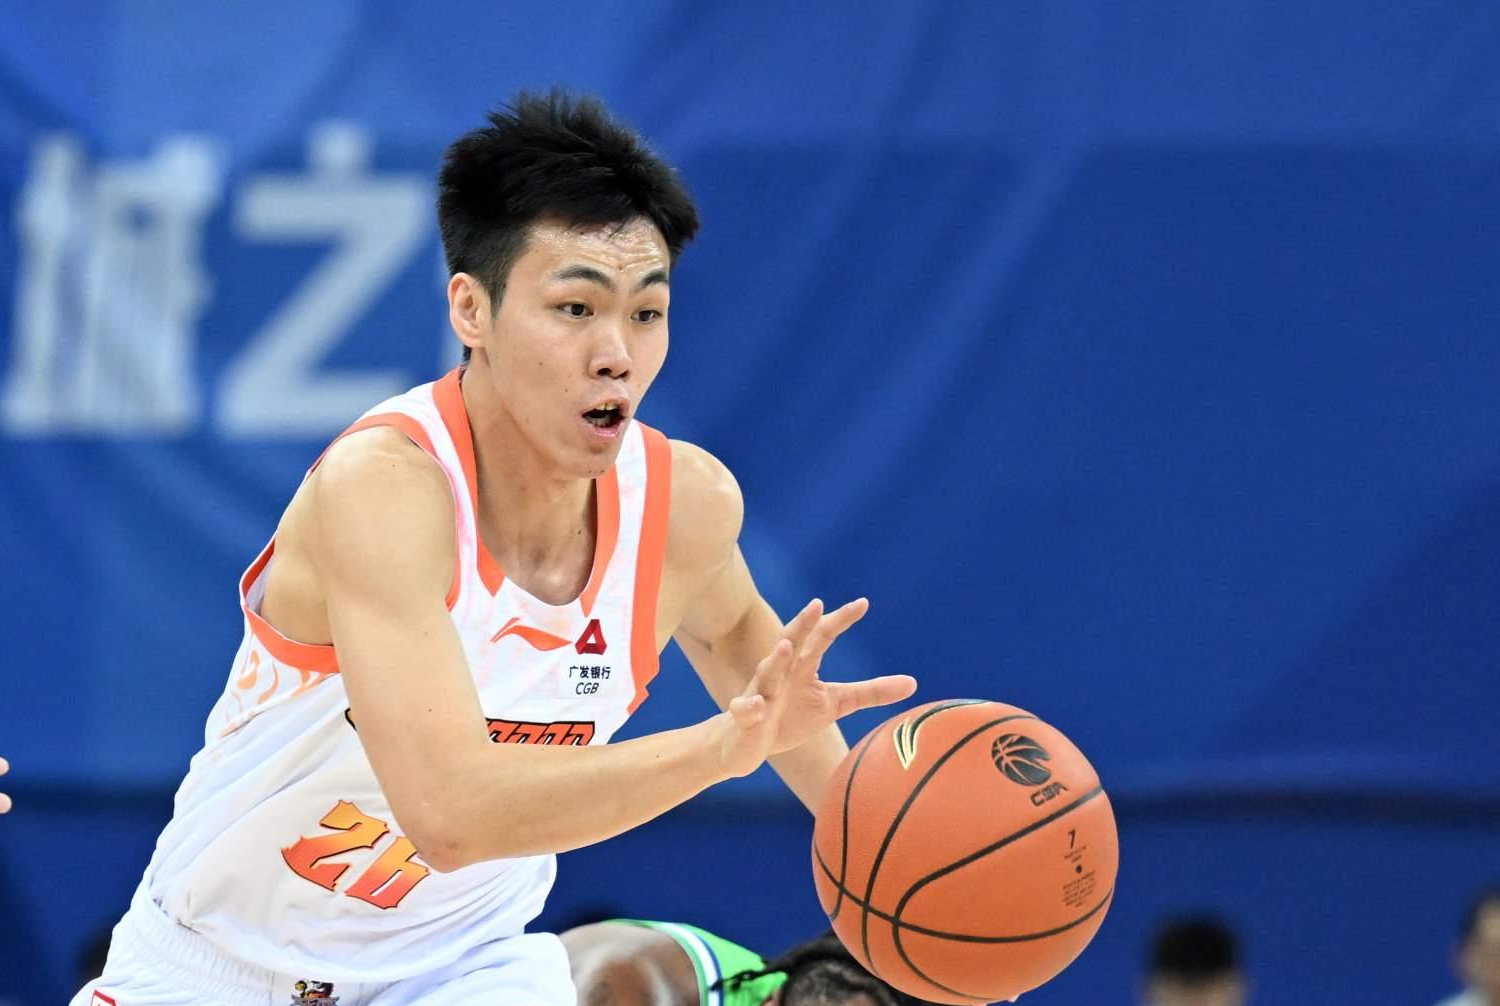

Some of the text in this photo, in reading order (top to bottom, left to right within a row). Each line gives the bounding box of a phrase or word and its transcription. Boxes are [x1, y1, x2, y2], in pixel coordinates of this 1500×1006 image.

[568, 665, 611, 680] 广发银行
[575, 682, 600, 696] CGB
